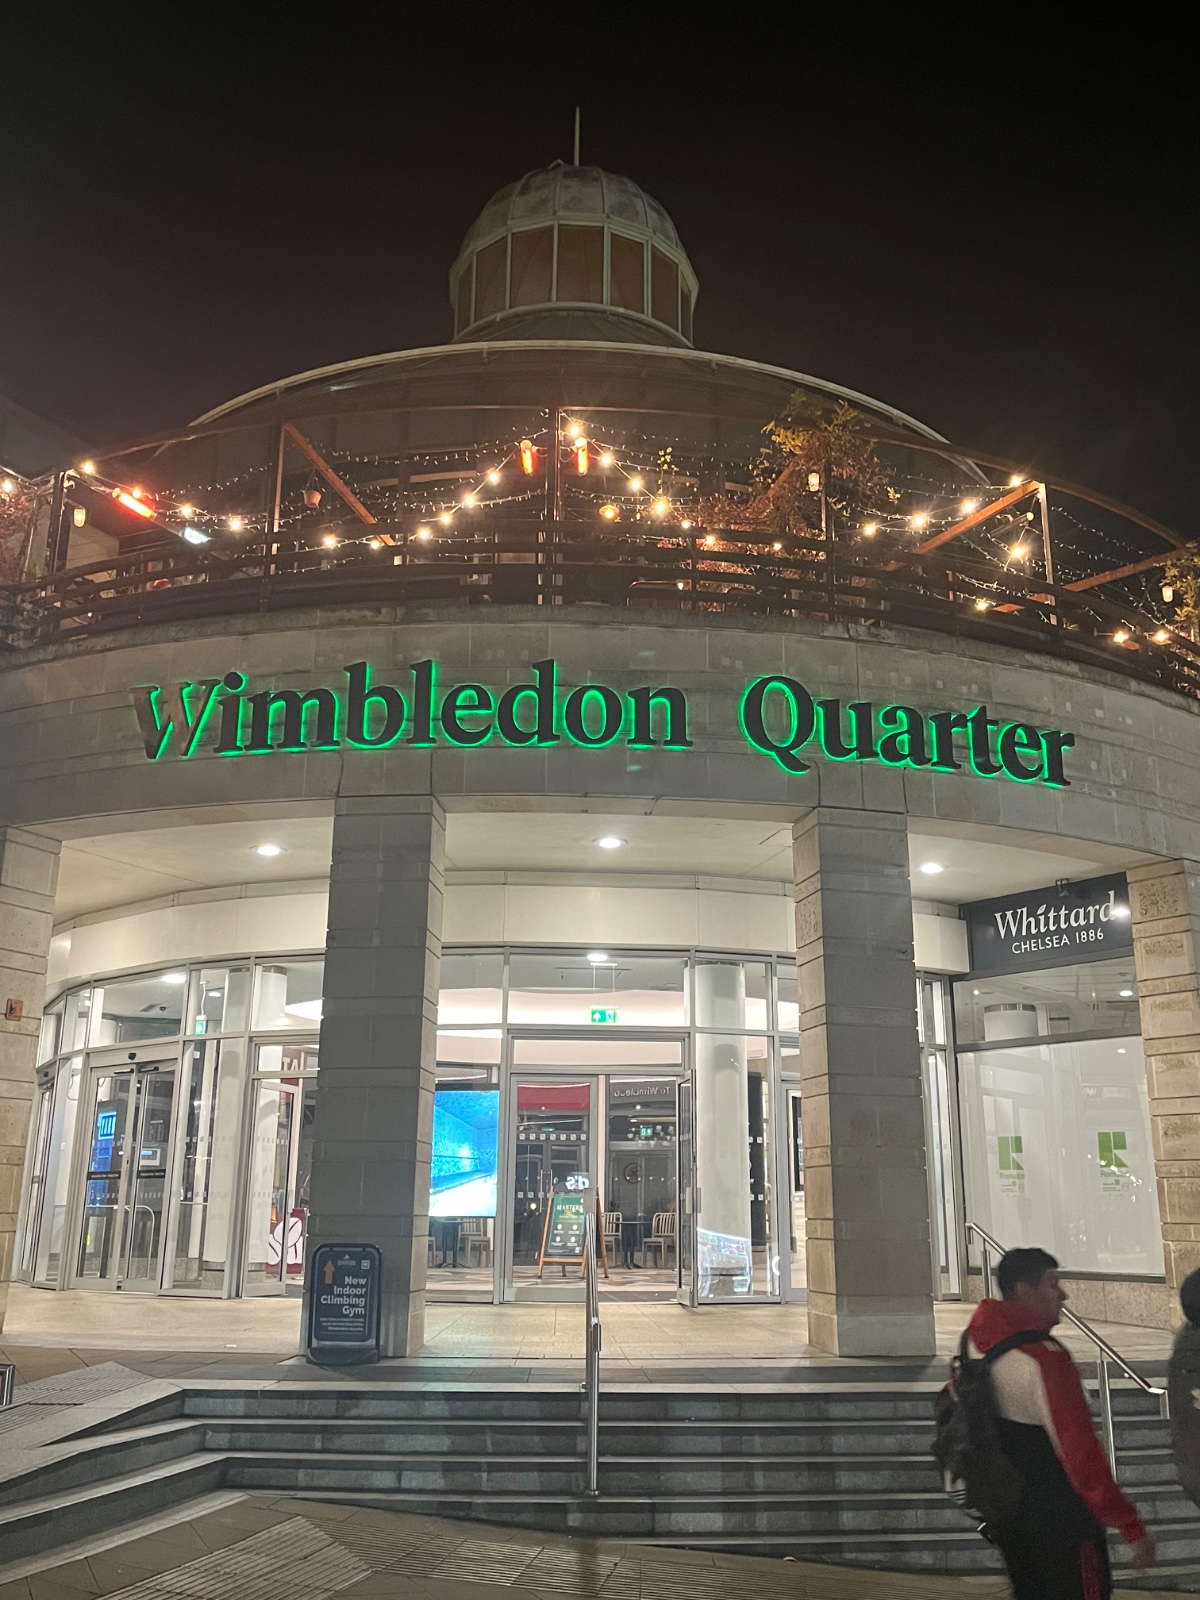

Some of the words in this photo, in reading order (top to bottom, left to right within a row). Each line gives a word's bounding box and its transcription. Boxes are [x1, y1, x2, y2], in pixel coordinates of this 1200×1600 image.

[130, 659, 692, 759] Wimbledon
[739, 675, 1075, 788] Quarter
[994, 890, 1117, 939] Whittard
[1011, 934, 1070, 954] CHELSEA
[1075, 928, 1104, 944] 1886
[344, 1276, 367, 1285] New
[333, 1285, 367, 1295] Indoor
[320, 1295, 365, 1306] Climbing
[342, 1305, 364, 1316] Gym
